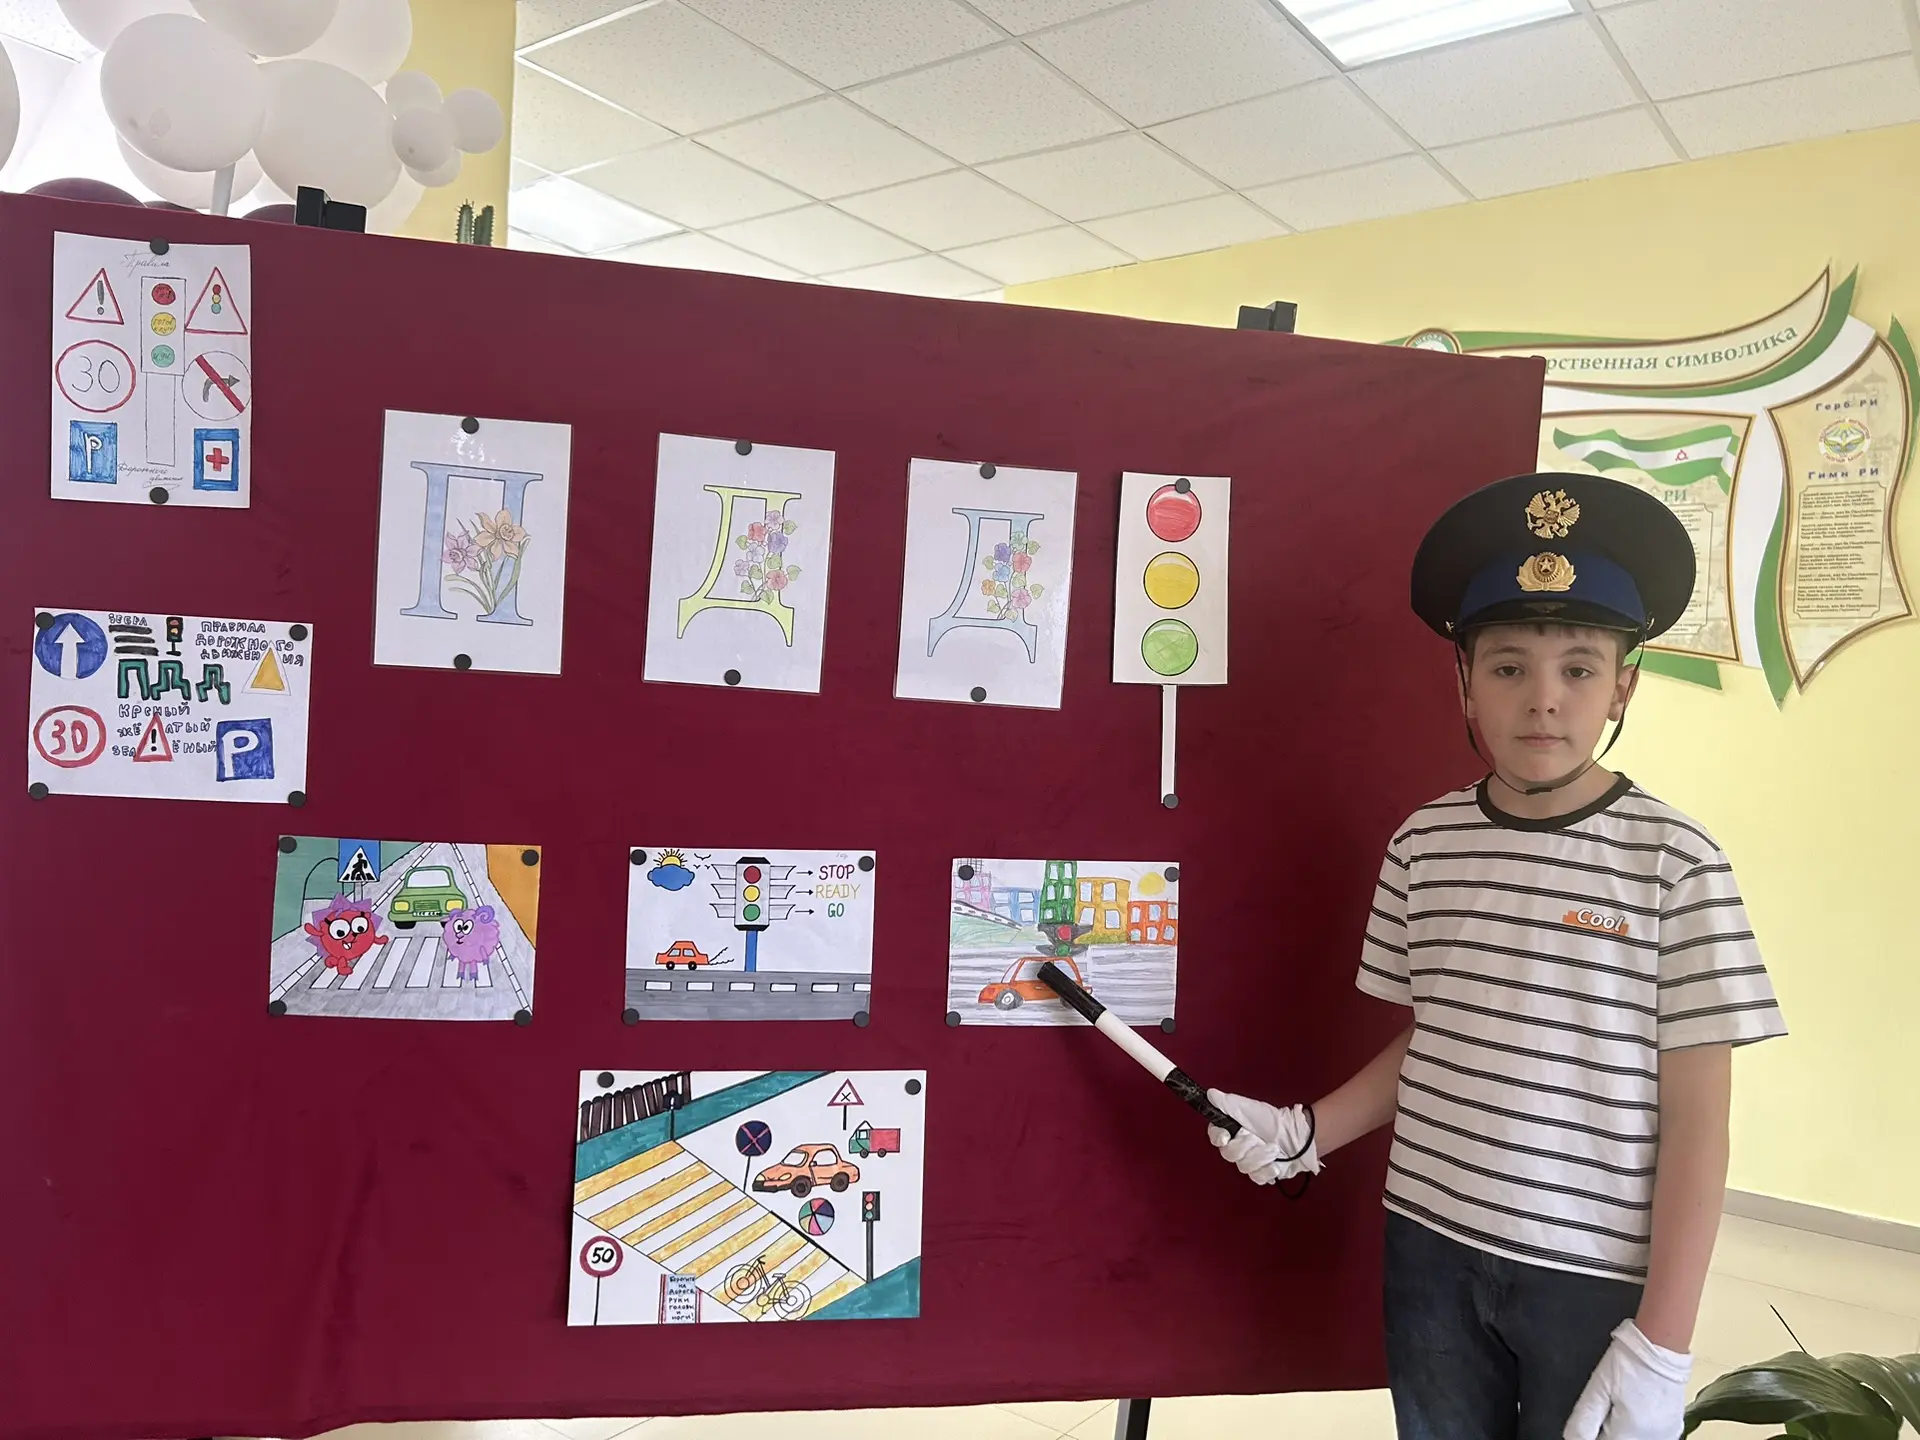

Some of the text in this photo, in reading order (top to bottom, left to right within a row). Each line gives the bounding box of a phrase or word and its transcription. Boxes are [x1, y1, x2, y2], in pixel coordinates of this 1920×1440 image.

[1665, 327, 1798, 369] символика
[71, 355, 121, 393] 30
[1815, 399, 1878, 411] Герб РИ
[1808, 468, 1879, 479] Гимн РИ
[1664, 489, 1688, 502] РИ
[400, 461, 544, 626] П
[677, 484, 802, 647] Д
[926, 507, 1045, 664] Д
[108, 613, 148, 626] ЗЕБРА
[201, 620, 266, 633] ПРАВИЛА
[117, 658, 231, 705] ПДД
[51, 718, 89, 755] 30
[222, 730, 259, 778] P
[818, 864, 855, 880] STOP
[815, 884, 861, 899] READY
[827, 903, 845, 918] GO
[1576, 908, 1626, 932] Cool
[591, 1248, 615, 1264] 50
